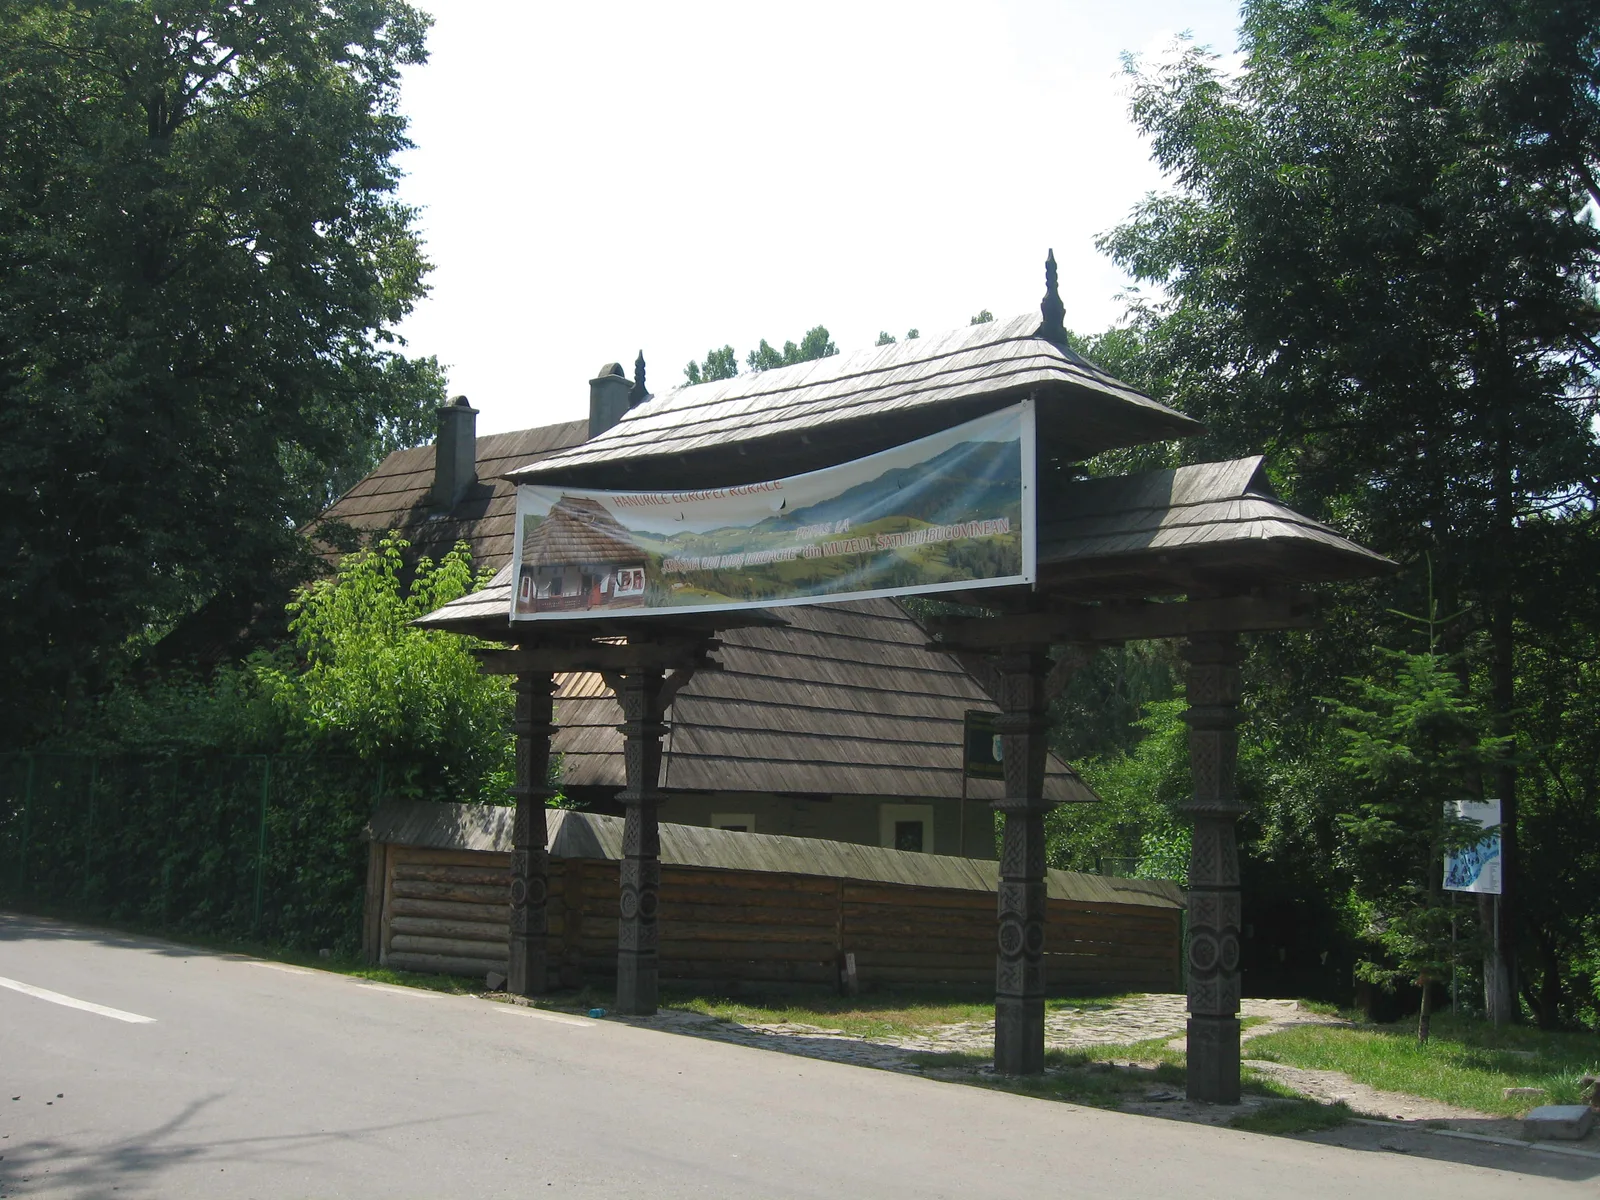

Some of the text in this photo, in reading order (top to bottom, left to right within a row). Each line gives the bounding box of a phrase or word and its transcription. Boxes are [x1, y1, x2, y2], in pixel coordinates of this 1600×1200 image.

[803, 543, 821, 560] din
[821, 535, 876, 557] MUZEUL
[876, 530, 926, 551] SATULUI
[926, 517, 1010, 544] BUCOVINEAN
